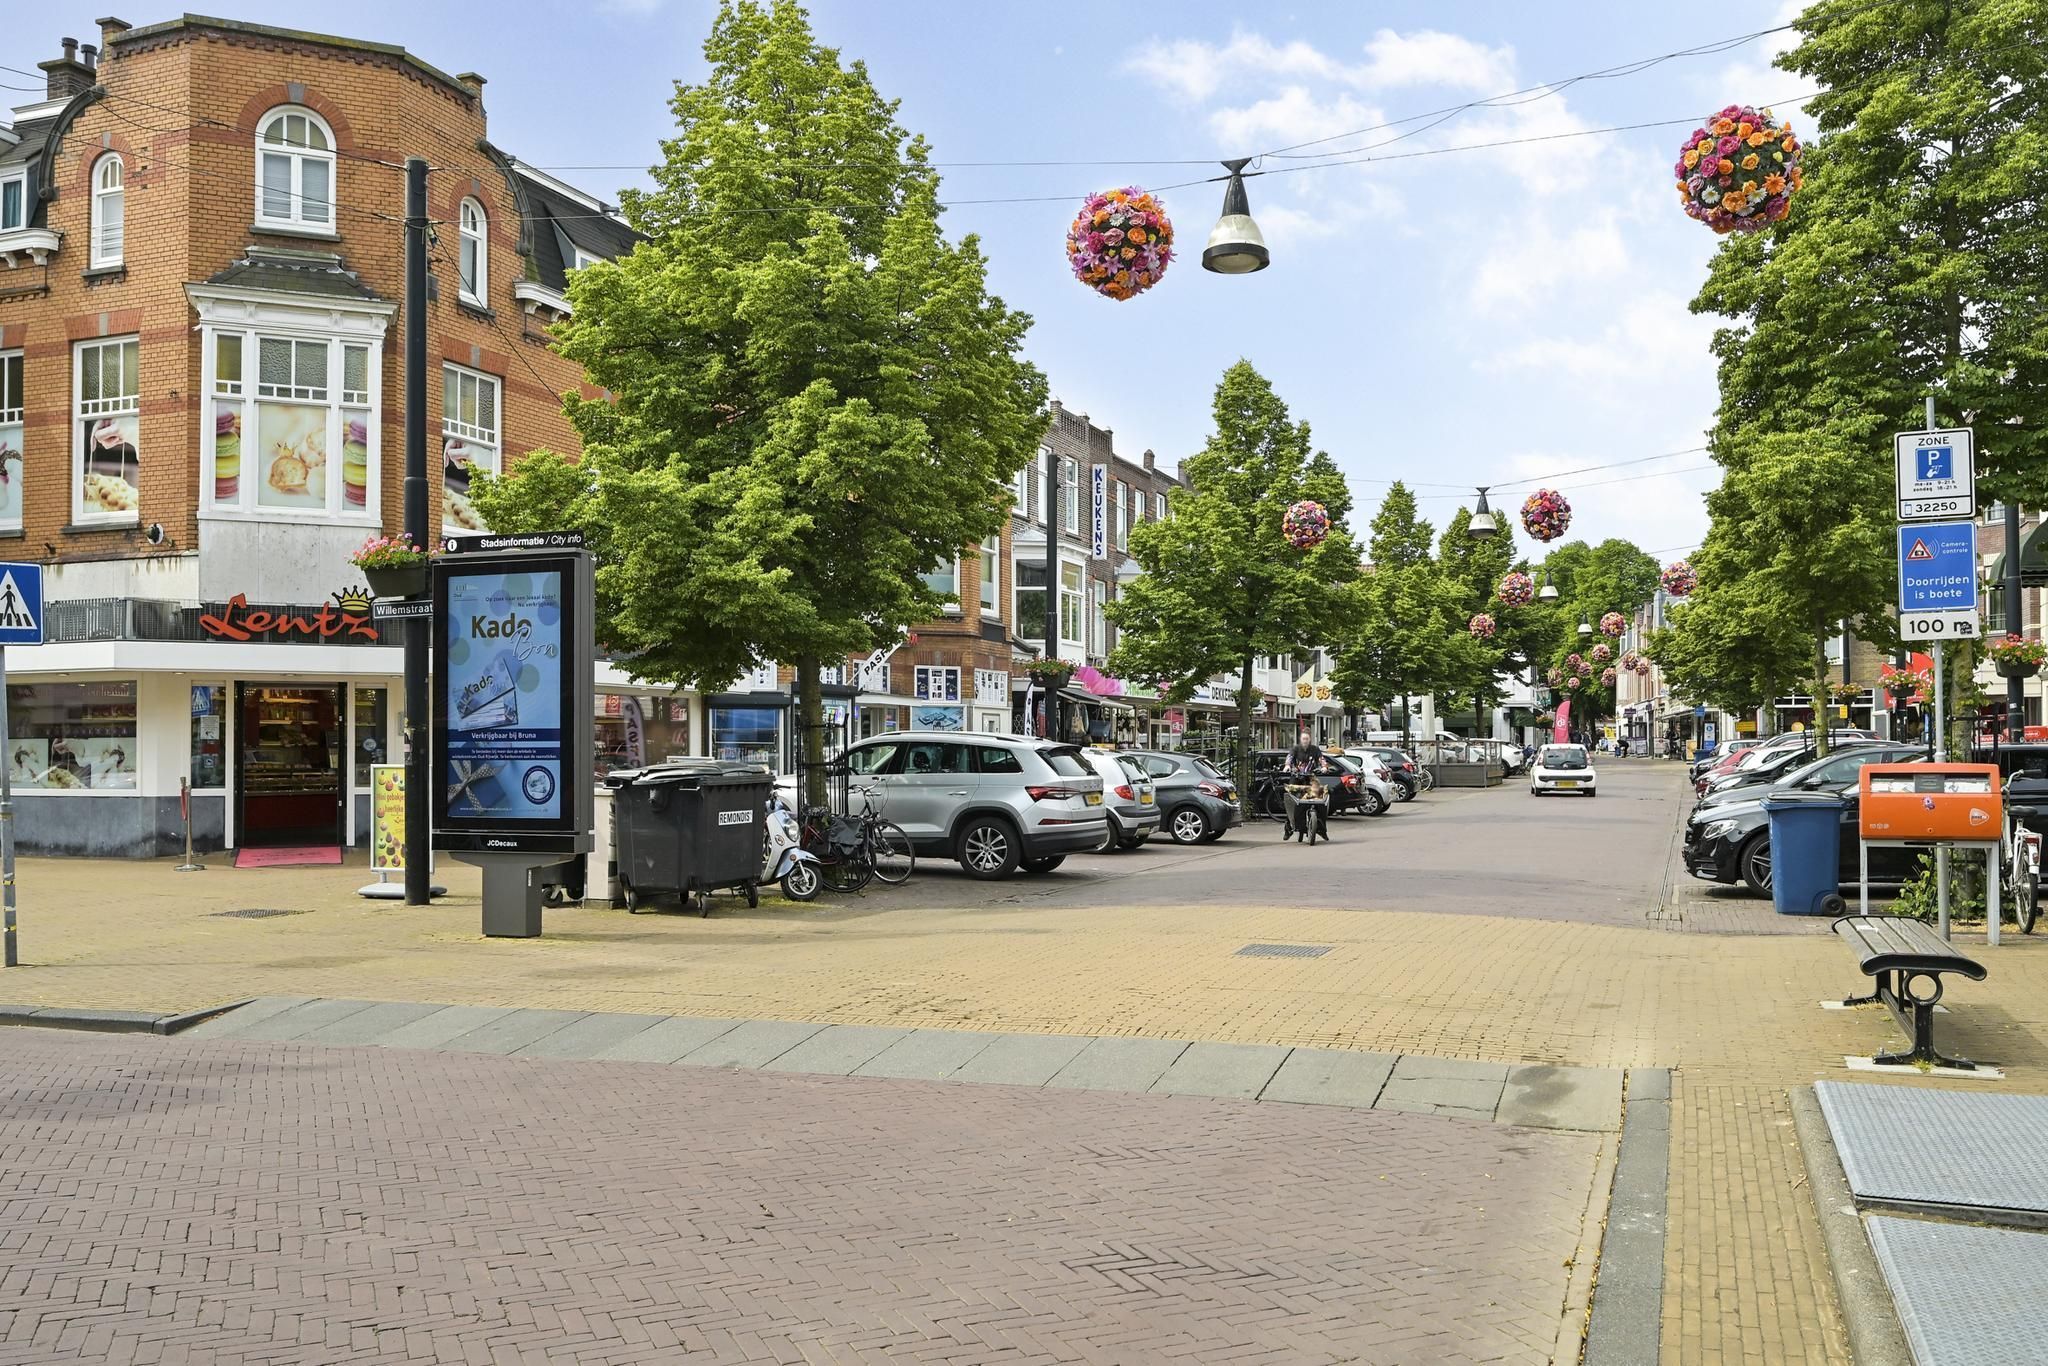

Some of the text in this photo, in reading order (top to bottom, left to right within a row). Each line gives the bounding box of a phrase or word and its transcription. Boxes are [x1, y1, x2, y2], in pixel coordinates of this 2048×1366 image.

[1918, 436, 1950, 446] ZONE
[1928, 450, 1940, 466] P
[1094, 468, 1103, 556] KEUKENS
[1915, 501, 1957, 513] 32250
[480, 537, 545, 549] Stadsinformatie
[550, 534, 566, 546] City
[567, 533, 582, 544] info
[1906, 575, 1970, 588] Doorrijden
[1914, 590, 1925, 600] is
[1929, 587, 1963, 599] boete
[376, 602, 433, 616] Willemstraat
[199, 592, 379, 641] Lentz
[471, 612, 532, 639] Kado
[1909, 619, 1944, 634] 100
[471, 732, 508, 740] Verkrijgbaar
[508, 732, 517, 740] bij
[719, 811, 750, 824] REMONDIS
[487, 839, 518, 847] JCDecaux
